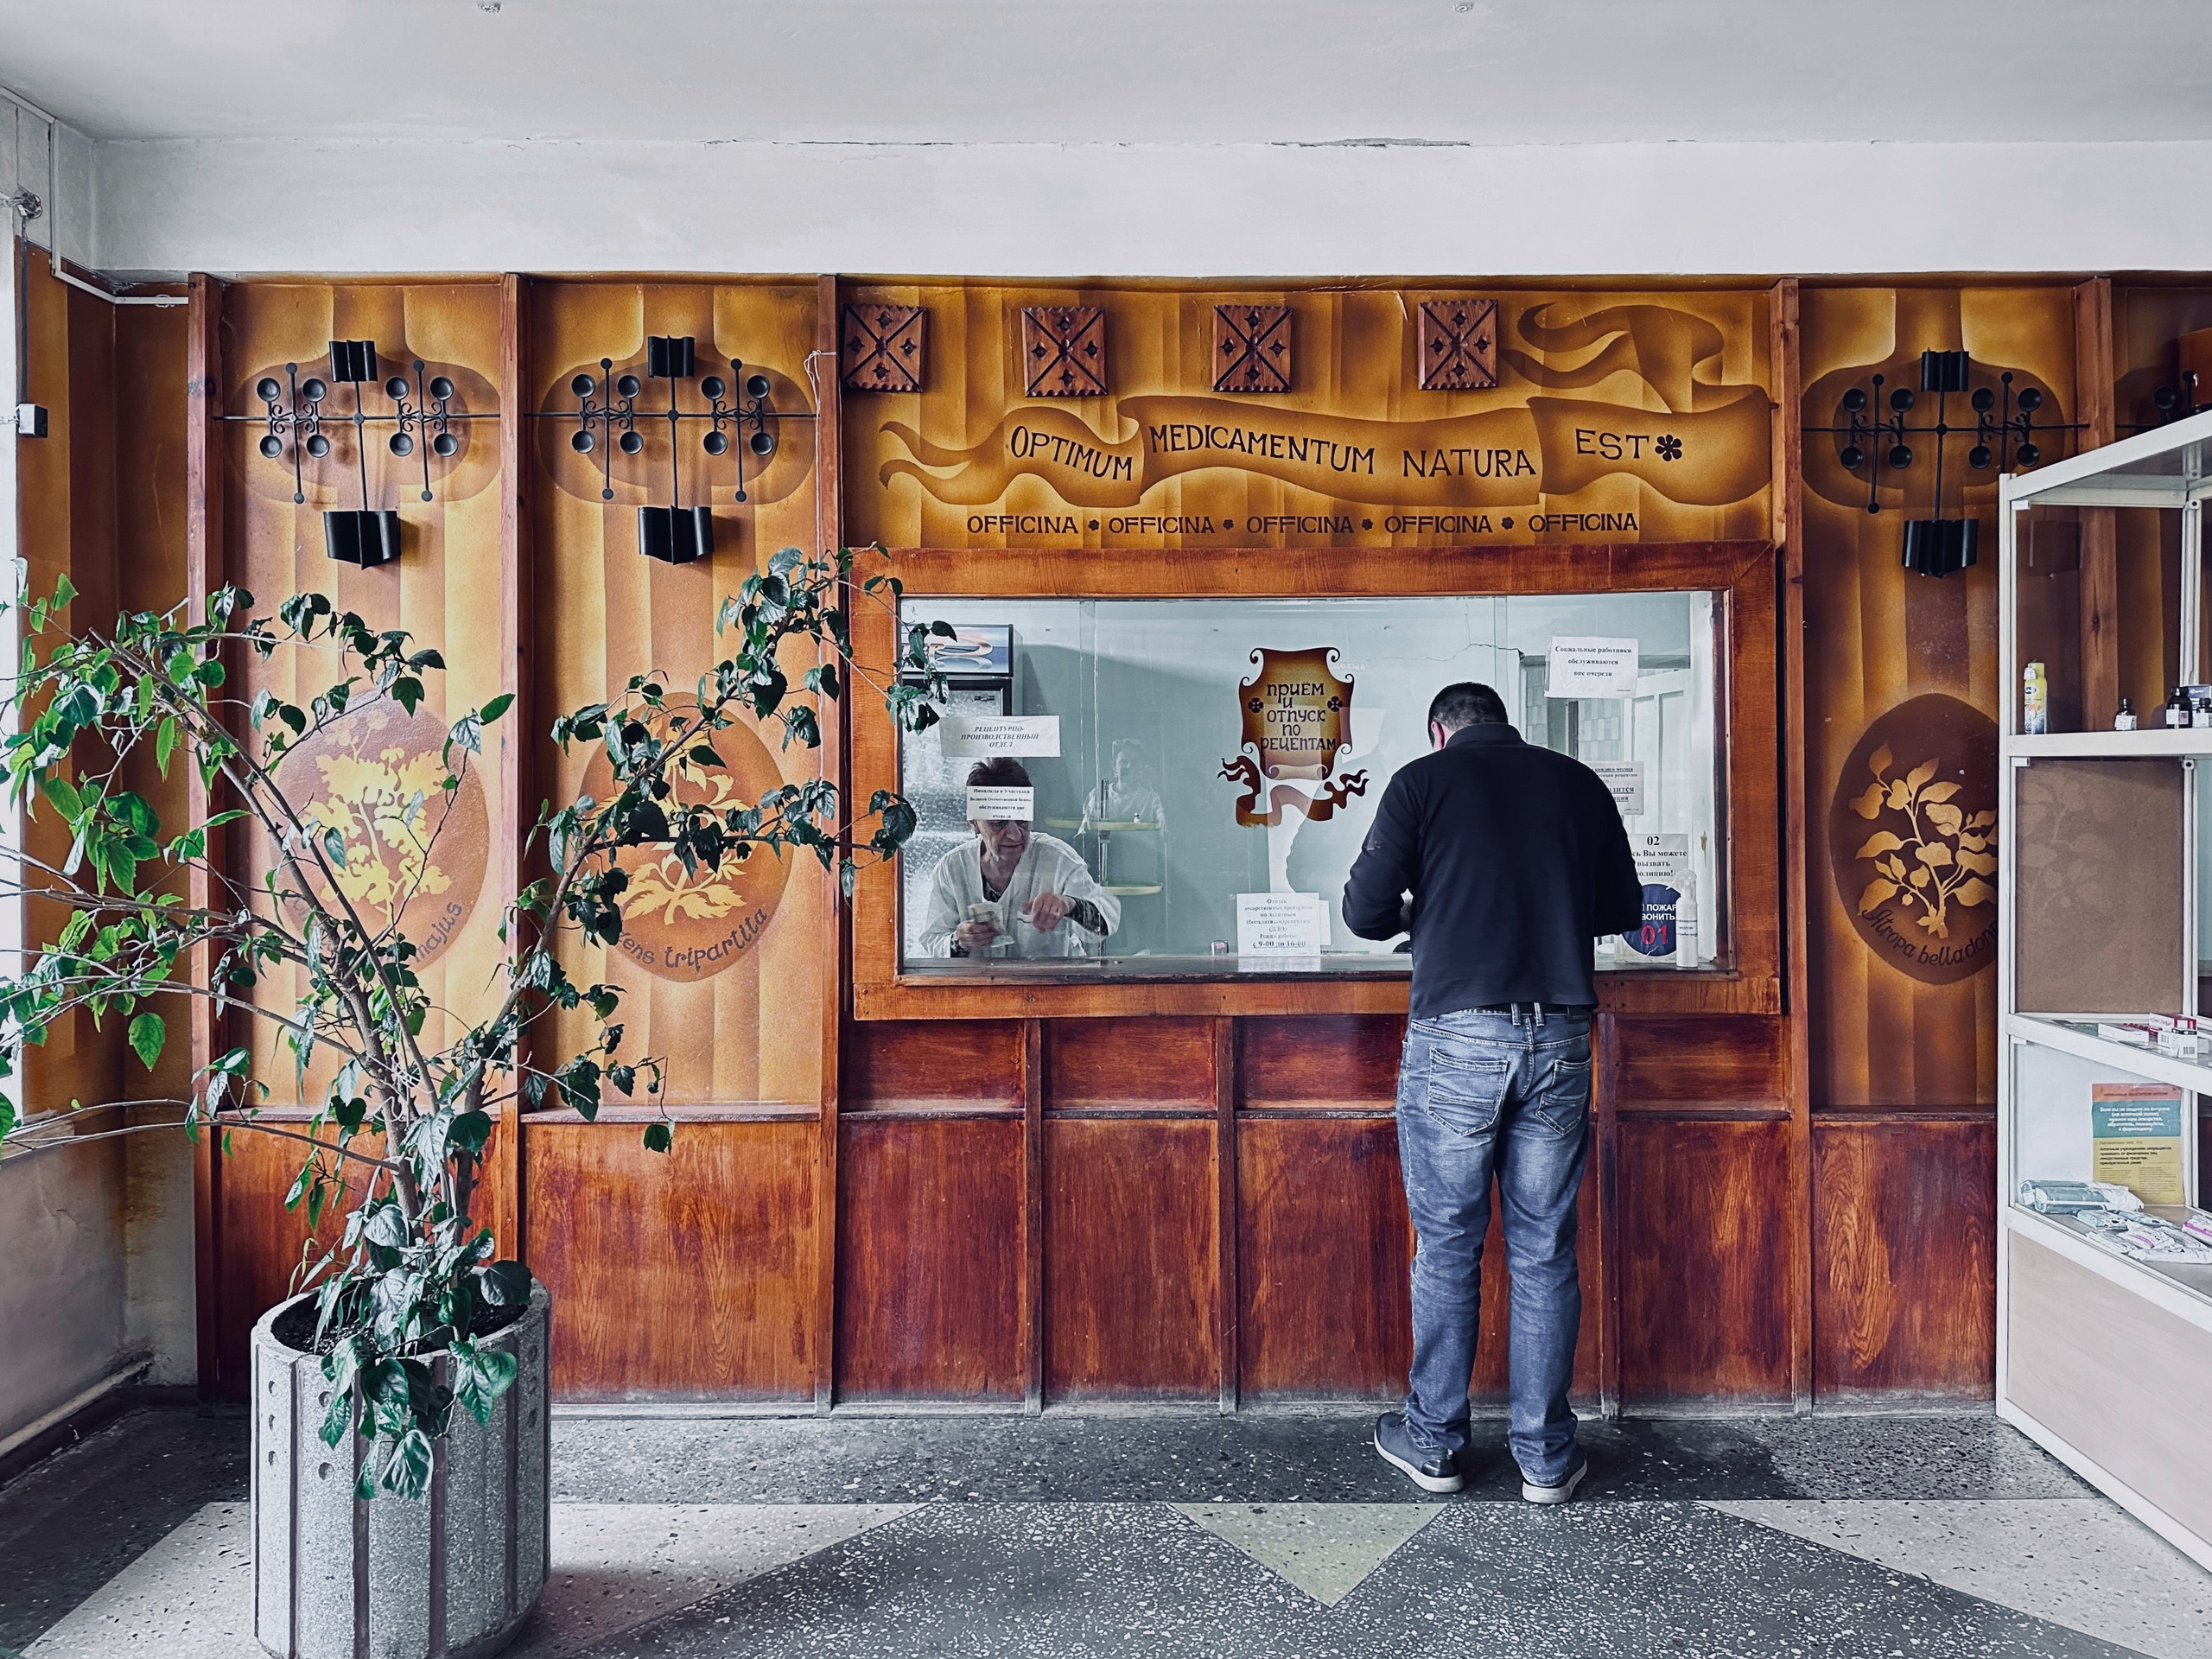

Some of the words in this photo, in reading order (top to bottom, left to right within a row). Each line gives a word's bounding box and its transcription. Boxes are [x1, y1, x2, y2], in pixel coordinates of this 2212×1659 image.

[1010, 425, 1133, 481] OPTIMUM
[1148, 424, 1376, 474] MEDICAMENTUM
[1403, 448, 1537, 478] NATURA
[1575, 428, 1650, 460] EST
[967, 515, 1079, 534] OFFICINA
[1108, 516, 1216, 534] OFFICINA
[1246, 515, 1355, 534] OFFICINA
[1383, 515, 1493, 534] OFFICINA
[1528, 512, 1639, 532] OFFICINA
[1647, 836, 1660, 846] 02
[664, 907, 768, 973] tripartita
[1642, 925, 1668, 945] 01
[1861, 908, 1916, 959] Atropa
